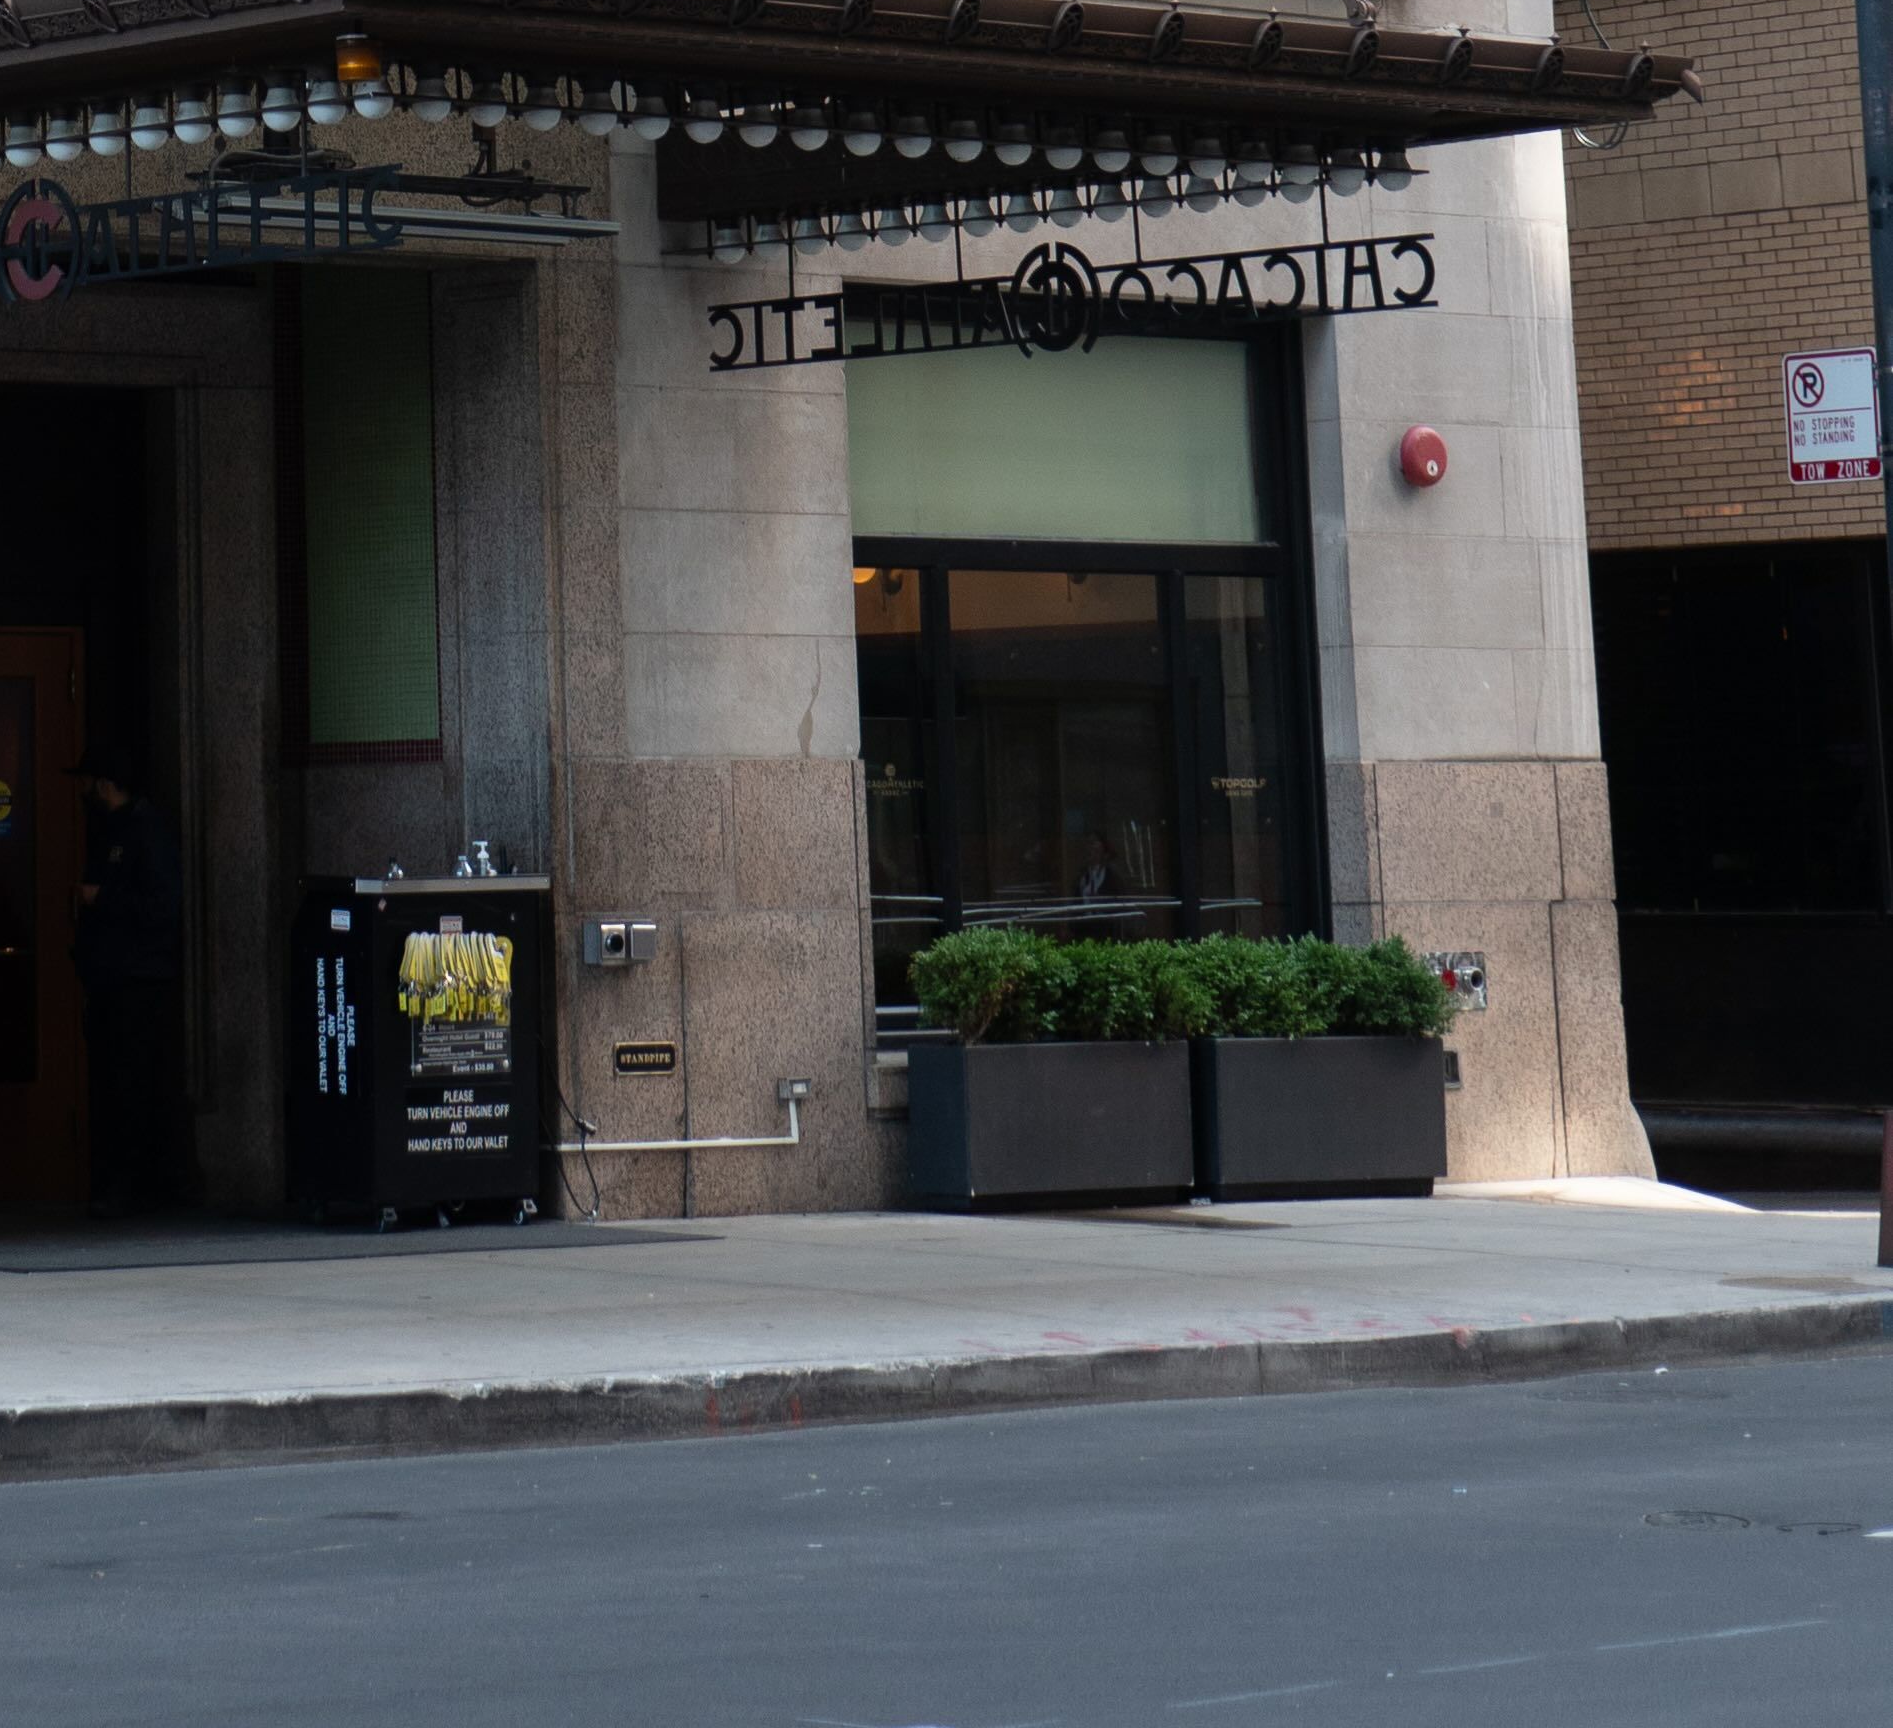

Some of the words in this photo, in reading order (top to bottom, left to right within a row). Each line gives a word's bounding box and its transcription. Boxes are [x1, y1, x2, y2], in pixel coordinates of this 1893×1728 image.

[82, 173, 404, 282] ATHLETIC
[1793, 418, 1805, 432] NO
[1812, 415, 1855, 432] STOPPING
[1793, 433, 1806, 447] NO
[1812, 429, 1855, 445] STANDING
[1800, 463, 1826, 481] TOW
[1837, 460, 1870, 479] ZONE
[317, 958, 325, 987] HAND
[336, 957, 344, 985] TURN
[318, 989, 326, 1017] KEYS
[337, 987, 345, 1031] VEHICLE
[318, 1019, 326, 1034] TO
[347, 1006, 355, 1046] PLEASE
[319, 1036, 327, 1058] OUR
[338, 1033, 346, 1072] ENGINE
[620, 1053, 672, 1064] STANDPIPE
[319, 1060, 327, 1093] VALET
[339, 1074, 347, 1095] OFF
[443, 1090, 474, 1103] PLEASE
[407, 1107, 428, 1120] TURN
[430, 1105, 463, 1120] VEHICLE
[464, 1104, 493, 1119] ENGINE
[494, 1104, 509, 1117] OFF
[450, 1122, 467, 1134] AND
[408, 1138, 430, 1151] HAND
[432, 1138, 453, 1151] KEYS
[454, 1137, 464, 1150] TO
[466, 1136, 483, 1149] OUR
[484, 1135, 508, 1149] VALET
